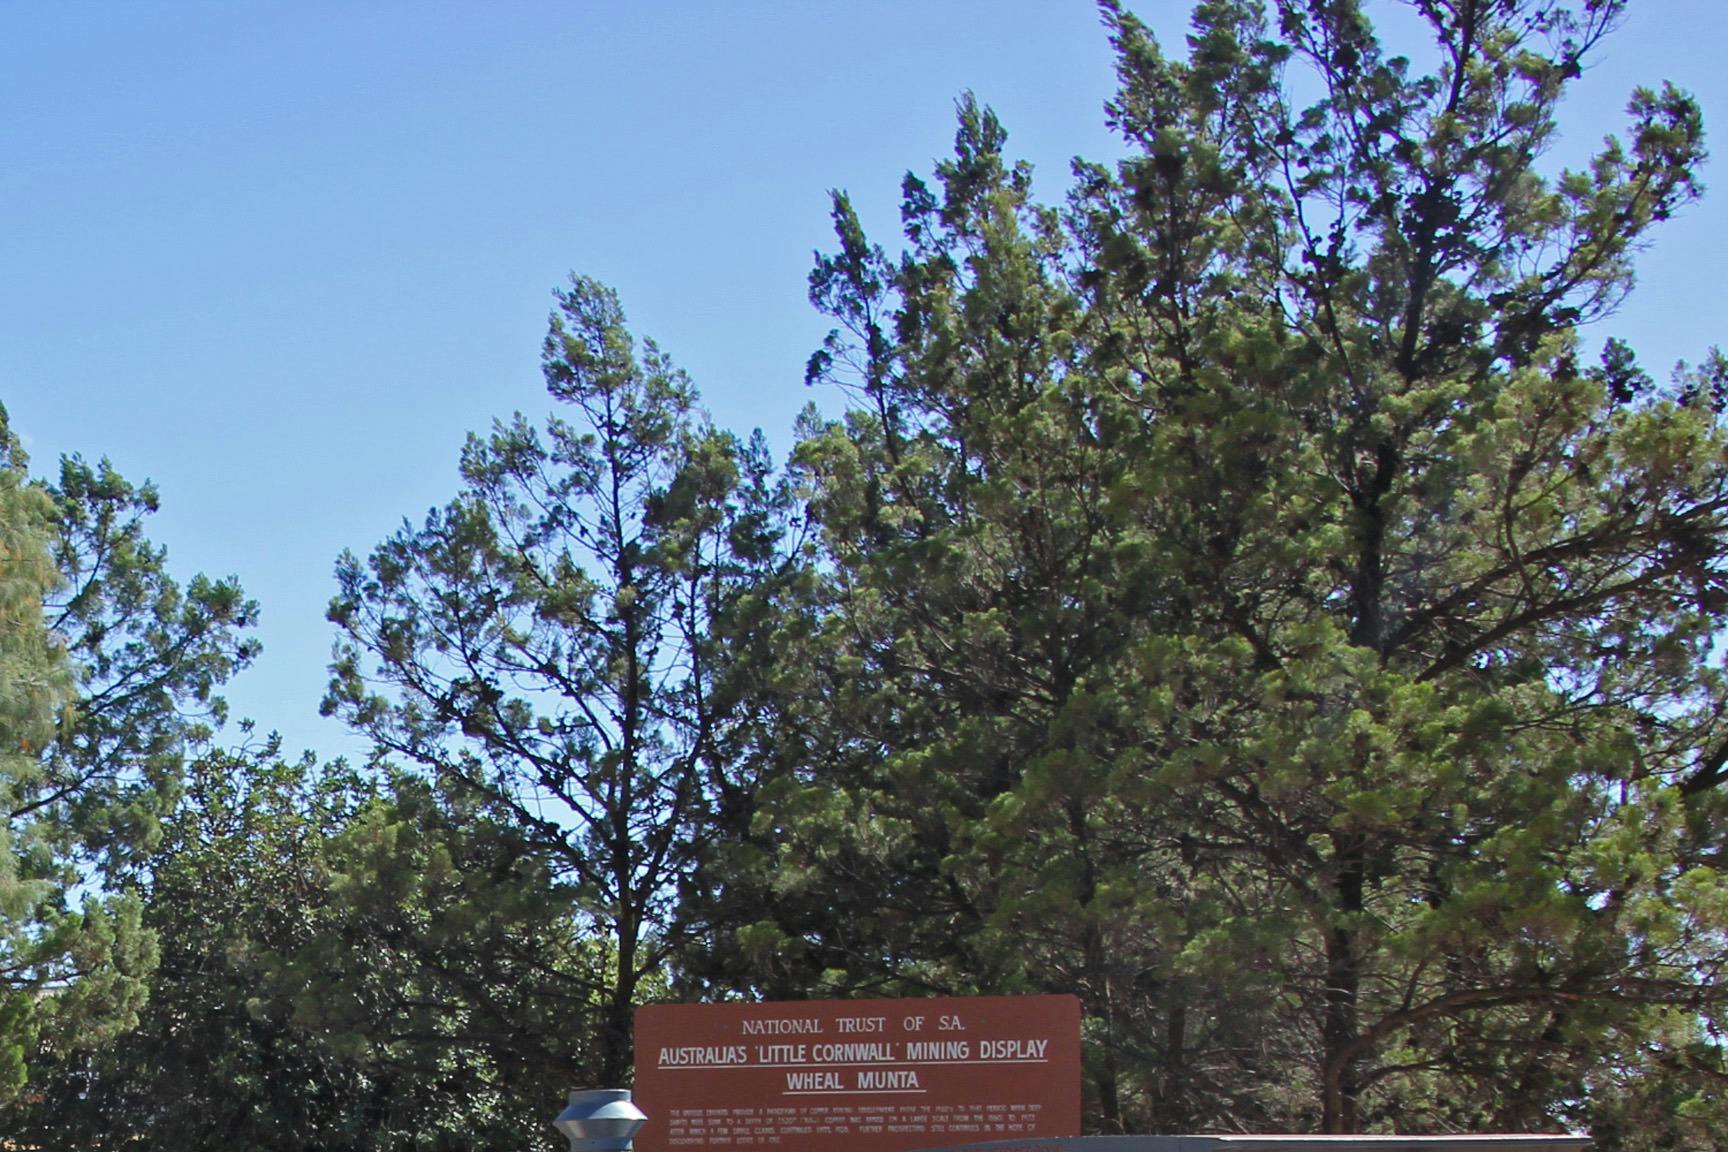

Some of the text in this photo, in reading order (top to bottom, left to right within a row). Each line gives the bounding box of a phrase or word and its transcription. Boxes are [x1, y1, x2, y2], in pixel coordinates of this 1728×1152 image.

[742, 1015, 965, 1035] NATIONAL TRUST OF S.A.
[658, 1046, 747, 1064] AUSTRALIA'S
[907, 1041, 969, 1060] MINING
[979, 1039, 1048, 1059] DISPLAY
[787, 1070, 919, 1090] WHEAL MUNTA
